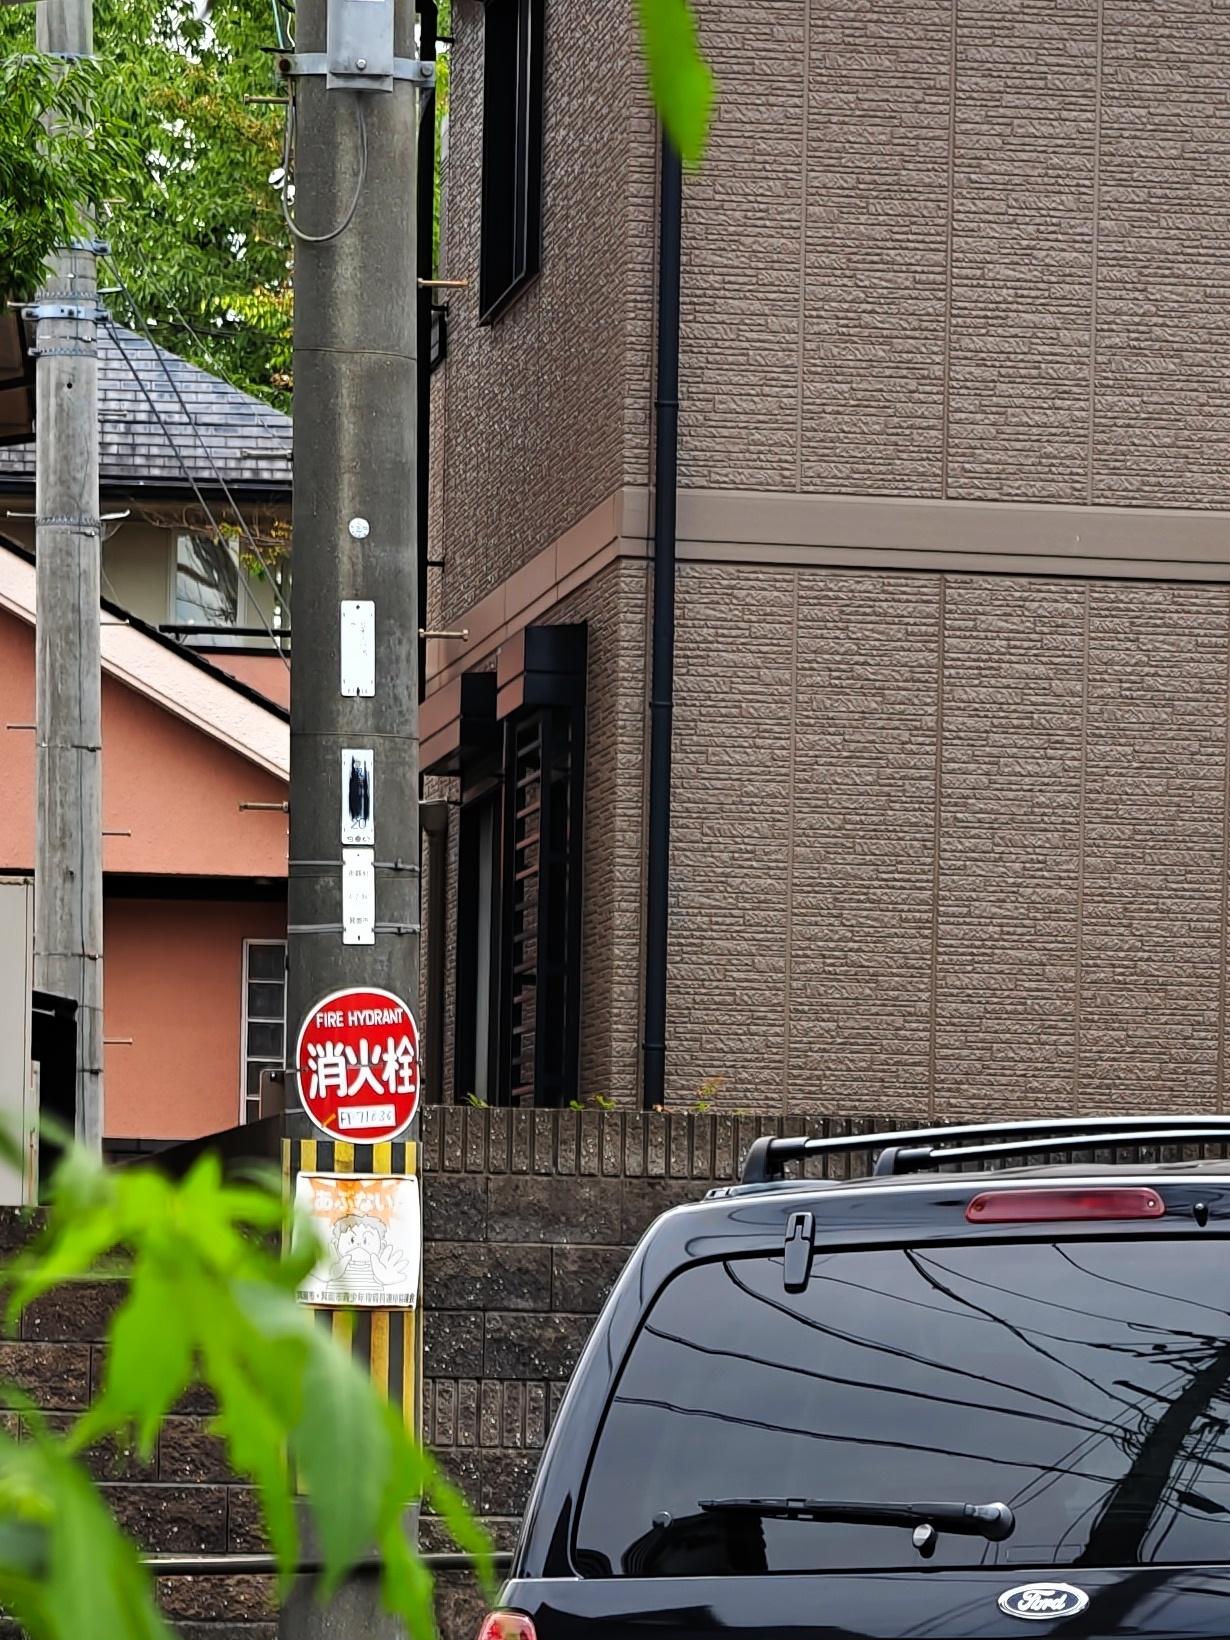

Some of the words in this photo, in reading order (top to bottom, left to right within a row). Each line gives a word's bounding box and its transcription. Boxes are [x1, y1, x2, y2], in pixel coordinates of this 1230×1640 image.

[316, 1010, 344, 1028] FIRE
[348, 1008, 403, 1027] HYDRANT
[307, 1035, 415, 1099] 消火栓
[1017, 1589, 1068, 1611] Ford
